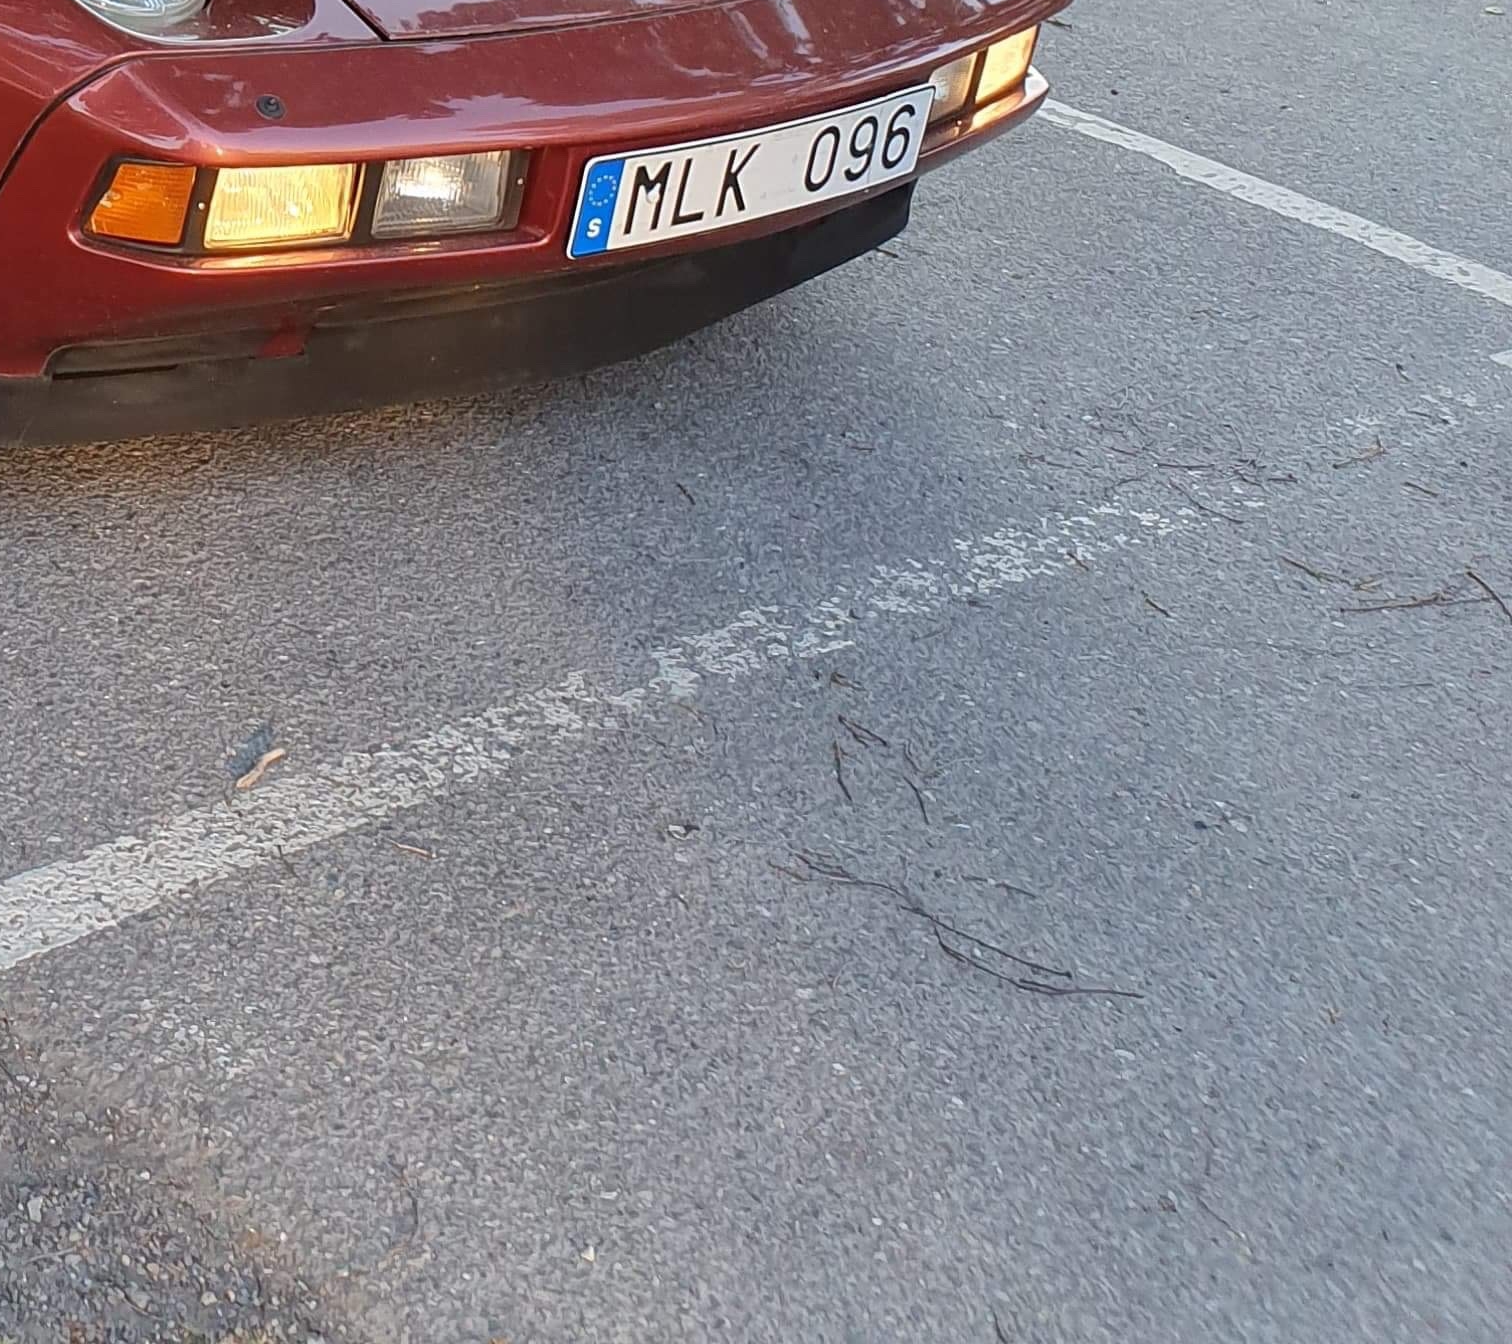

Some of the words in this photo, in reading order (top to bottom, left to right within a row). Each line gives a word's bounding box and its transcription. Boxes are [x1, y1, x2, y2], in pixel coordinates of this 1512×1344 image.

[623, 142, 762, 236] MLK
[804, 103, 916, 193] 096
[586, 217, 602, 239] S
